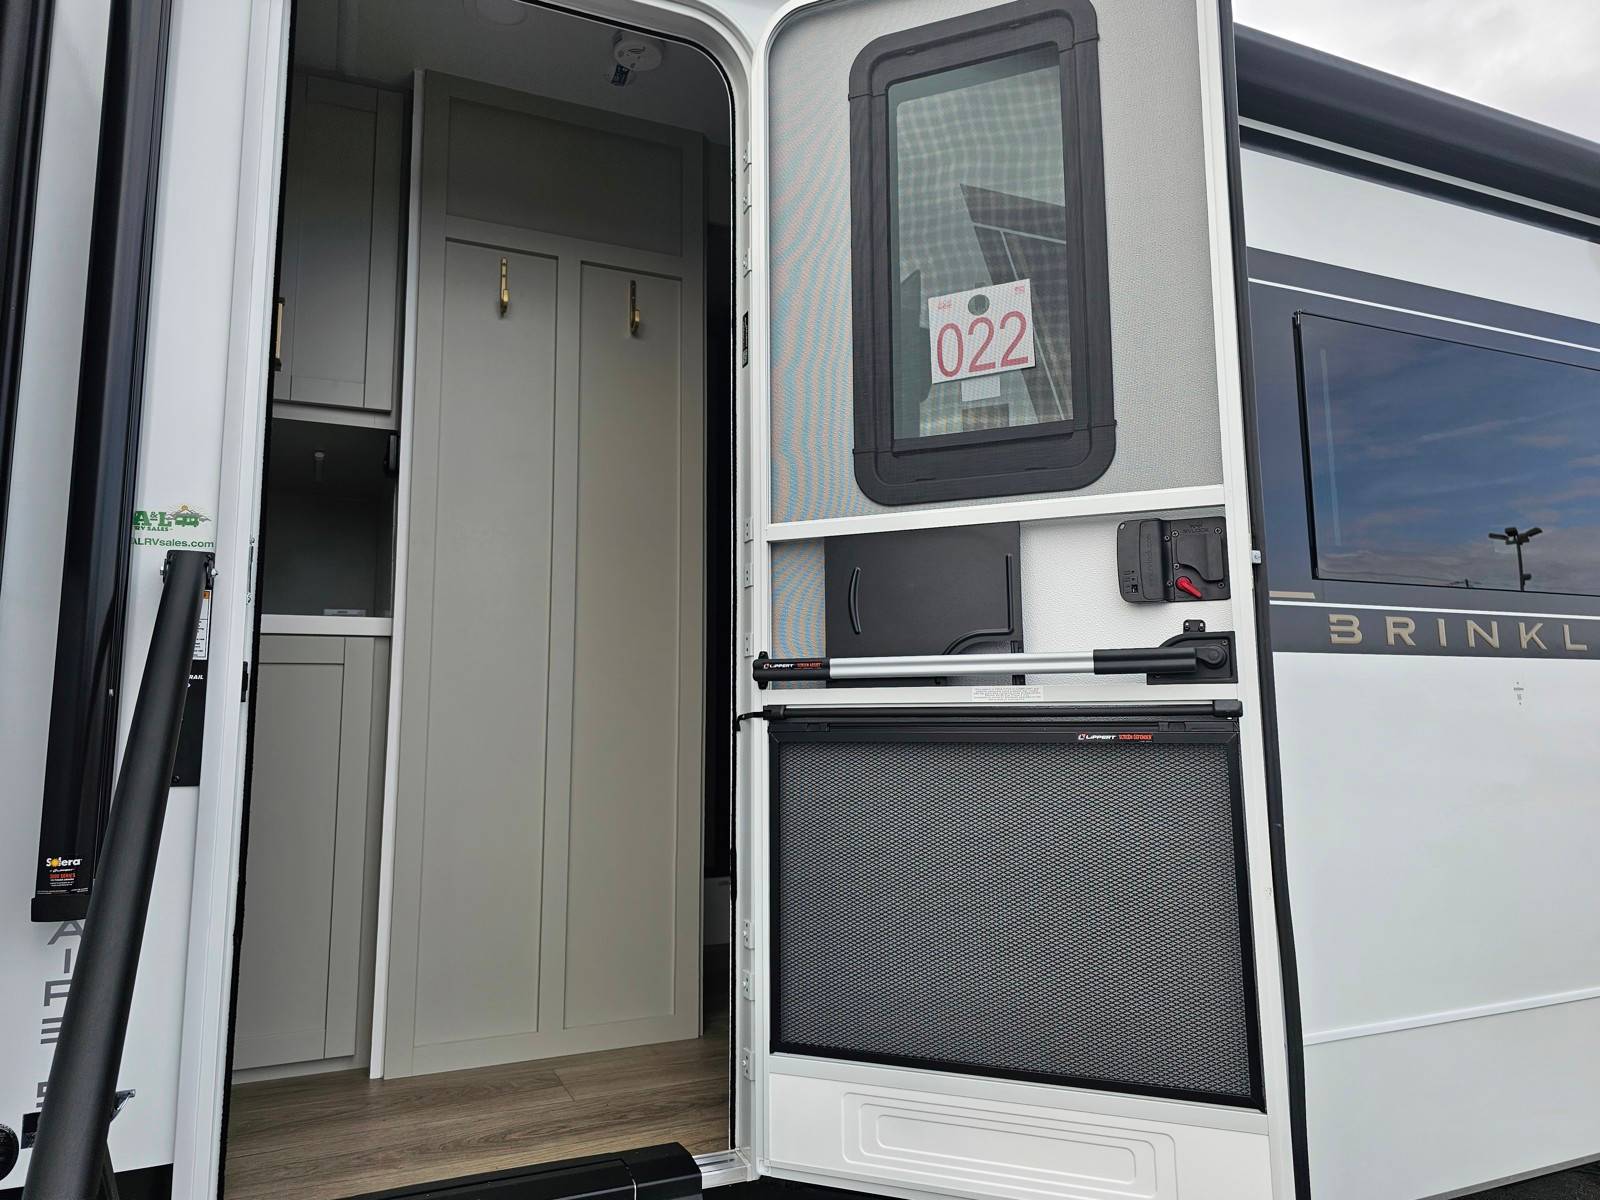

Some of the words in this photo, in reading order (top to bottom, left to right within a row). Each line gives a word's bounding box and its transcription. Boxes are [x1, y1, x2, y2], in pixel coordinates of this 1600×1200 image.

[937, 310, 1029, 378] 022
[1328, 613, 1587, 651] BRINKL
[46, 856, 81, 867] Solera
